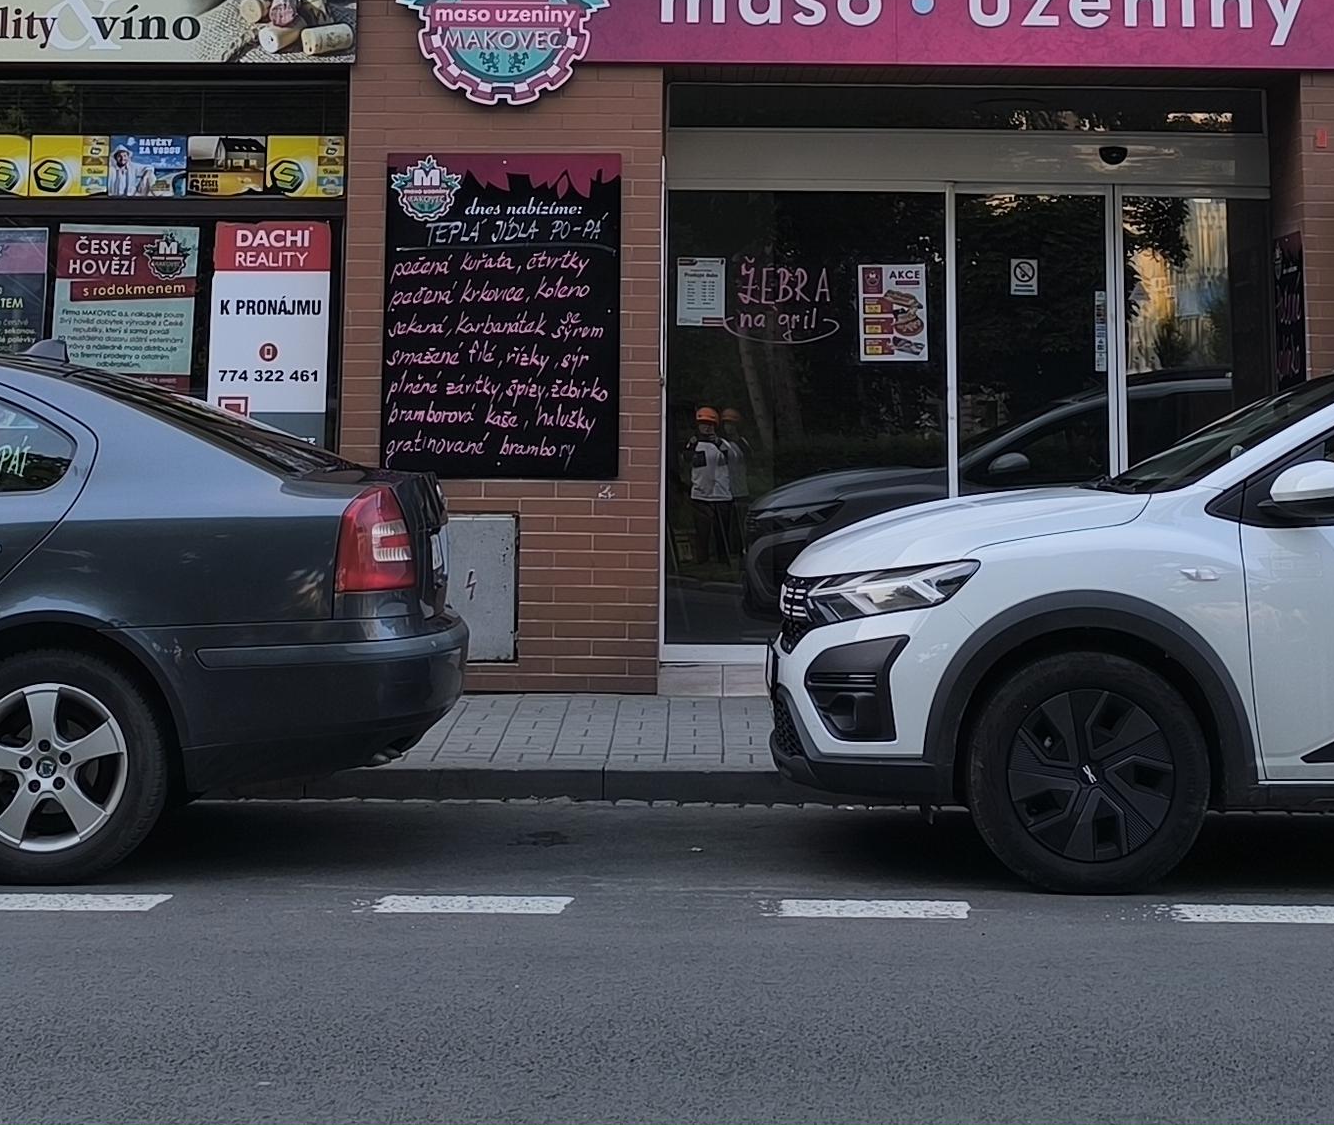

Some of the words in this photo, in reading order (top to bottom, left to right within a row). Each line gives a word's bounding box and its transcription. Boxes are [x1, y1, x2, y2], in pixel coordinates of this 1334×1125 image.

[92, 5, 202, 40] víno
[435, 8, 491, 22] maso
[495, 5, 576, 26] uzeniny
[441, 30, 567, 50] MAKOVEC
[465, 197, 501, 215] dnes
[506, 196, 583, 216] nabízíme:
[236, 230, 310, 247] DACHI
[425, 217, 488, 246] TEPLÁ
[491, 216, 539, 243] JÍDLA
[75, 235, 132, 256] ČESKÉ
[68, 255, 136, 276] HOVĚZÍ
[235, 251, 309, 267] REALITY
[738, 256, 830, 304] ŽEBRA
[889, 270, 920, 280] AKCE
[83, 287, 90, 297] s
[93, 282, 186, 297] rodokmenem
[82, 309, 117, 317] MAKOVEC
[220, 300, 230, 316] K
[236, 296, 322, 316] PRONÁJMU
[740, 313, 765, 329] na
[778, 307, 817, 343] gril
[218, 370, 248, 383] 774
[254, 370, 284, 383] 322
[289, 370, 319, 383] 461
